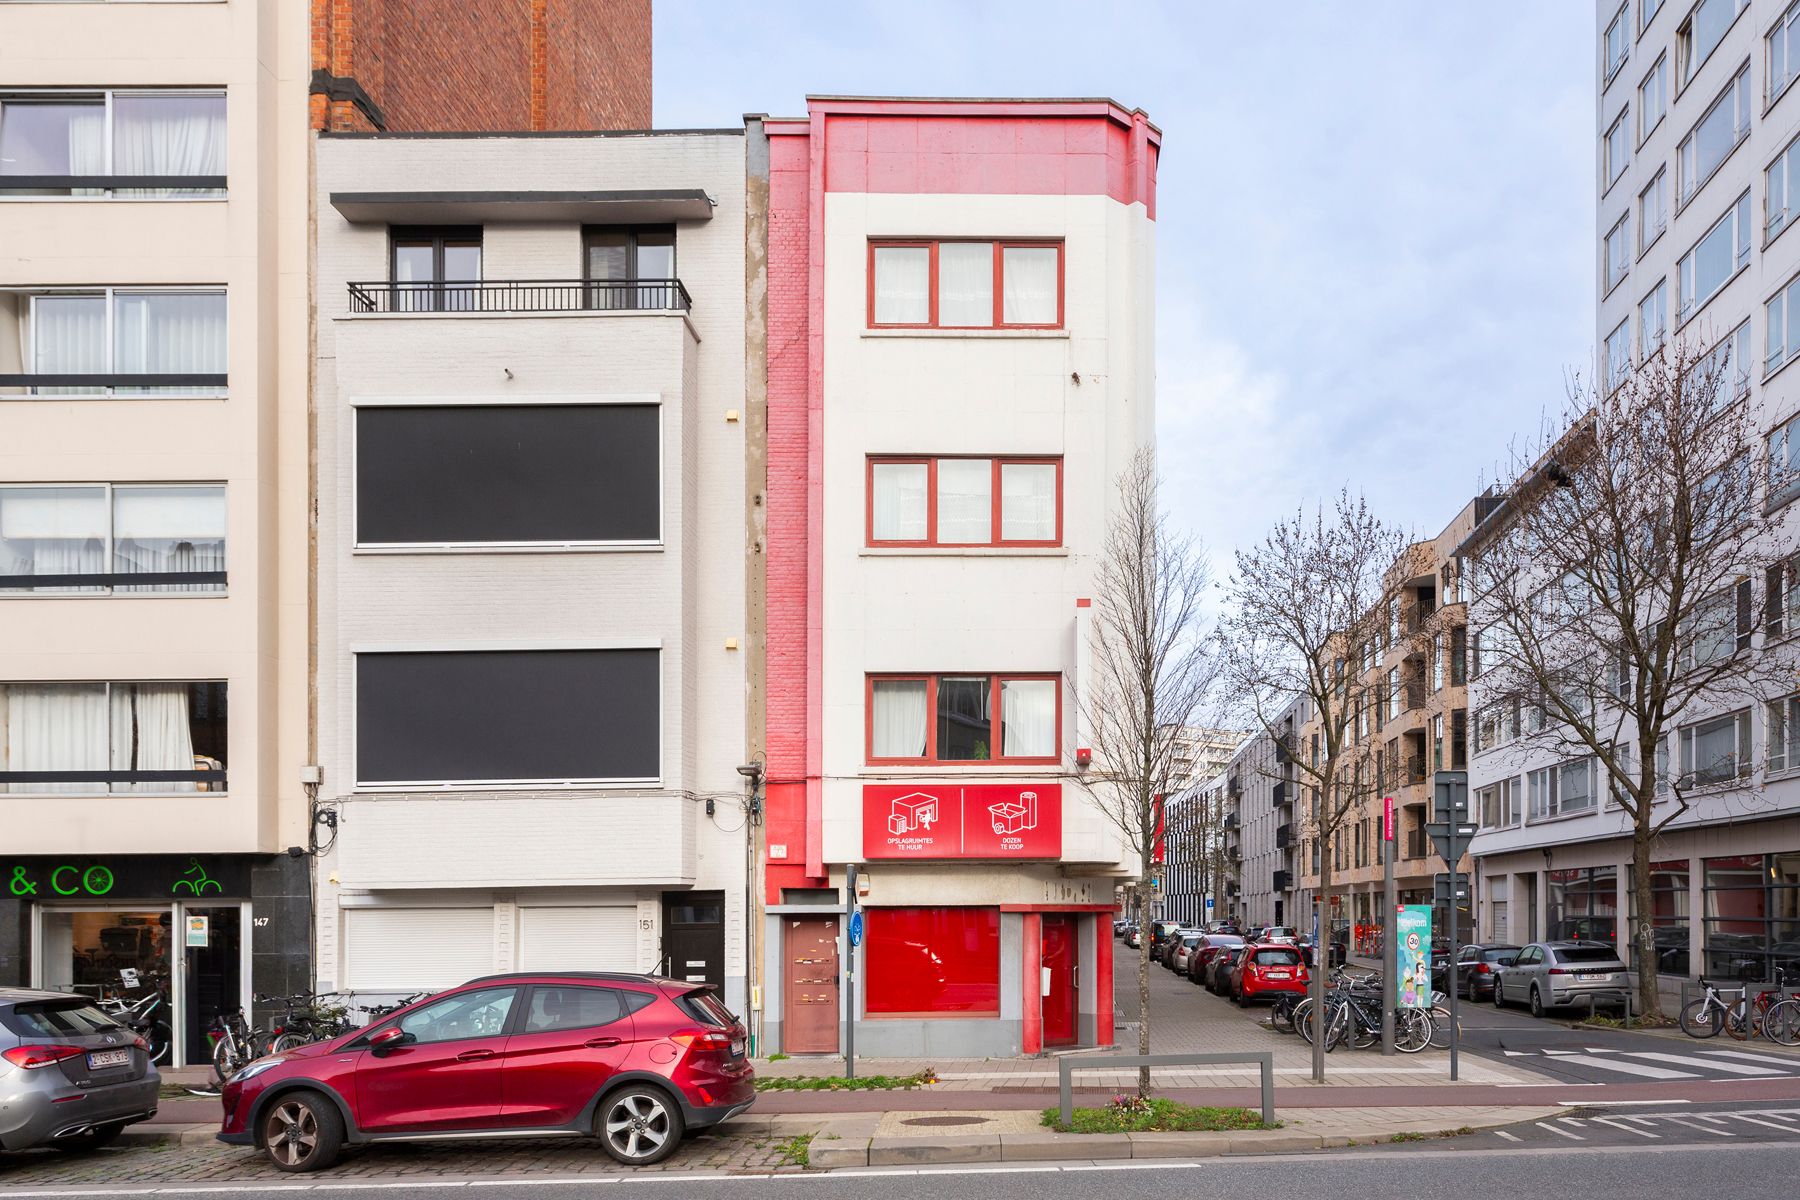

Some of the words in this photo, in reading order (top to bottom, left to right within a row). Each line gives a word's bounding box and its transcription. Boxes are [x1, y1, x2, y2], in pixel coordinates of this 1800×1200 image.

[9, 865, 37, 895] &
[51, 865, 114, 895] CO
[253, 917, 269, 927] 147
[639, 919, 654, 930] 151
[1409, 937, 1419, 945] 30
